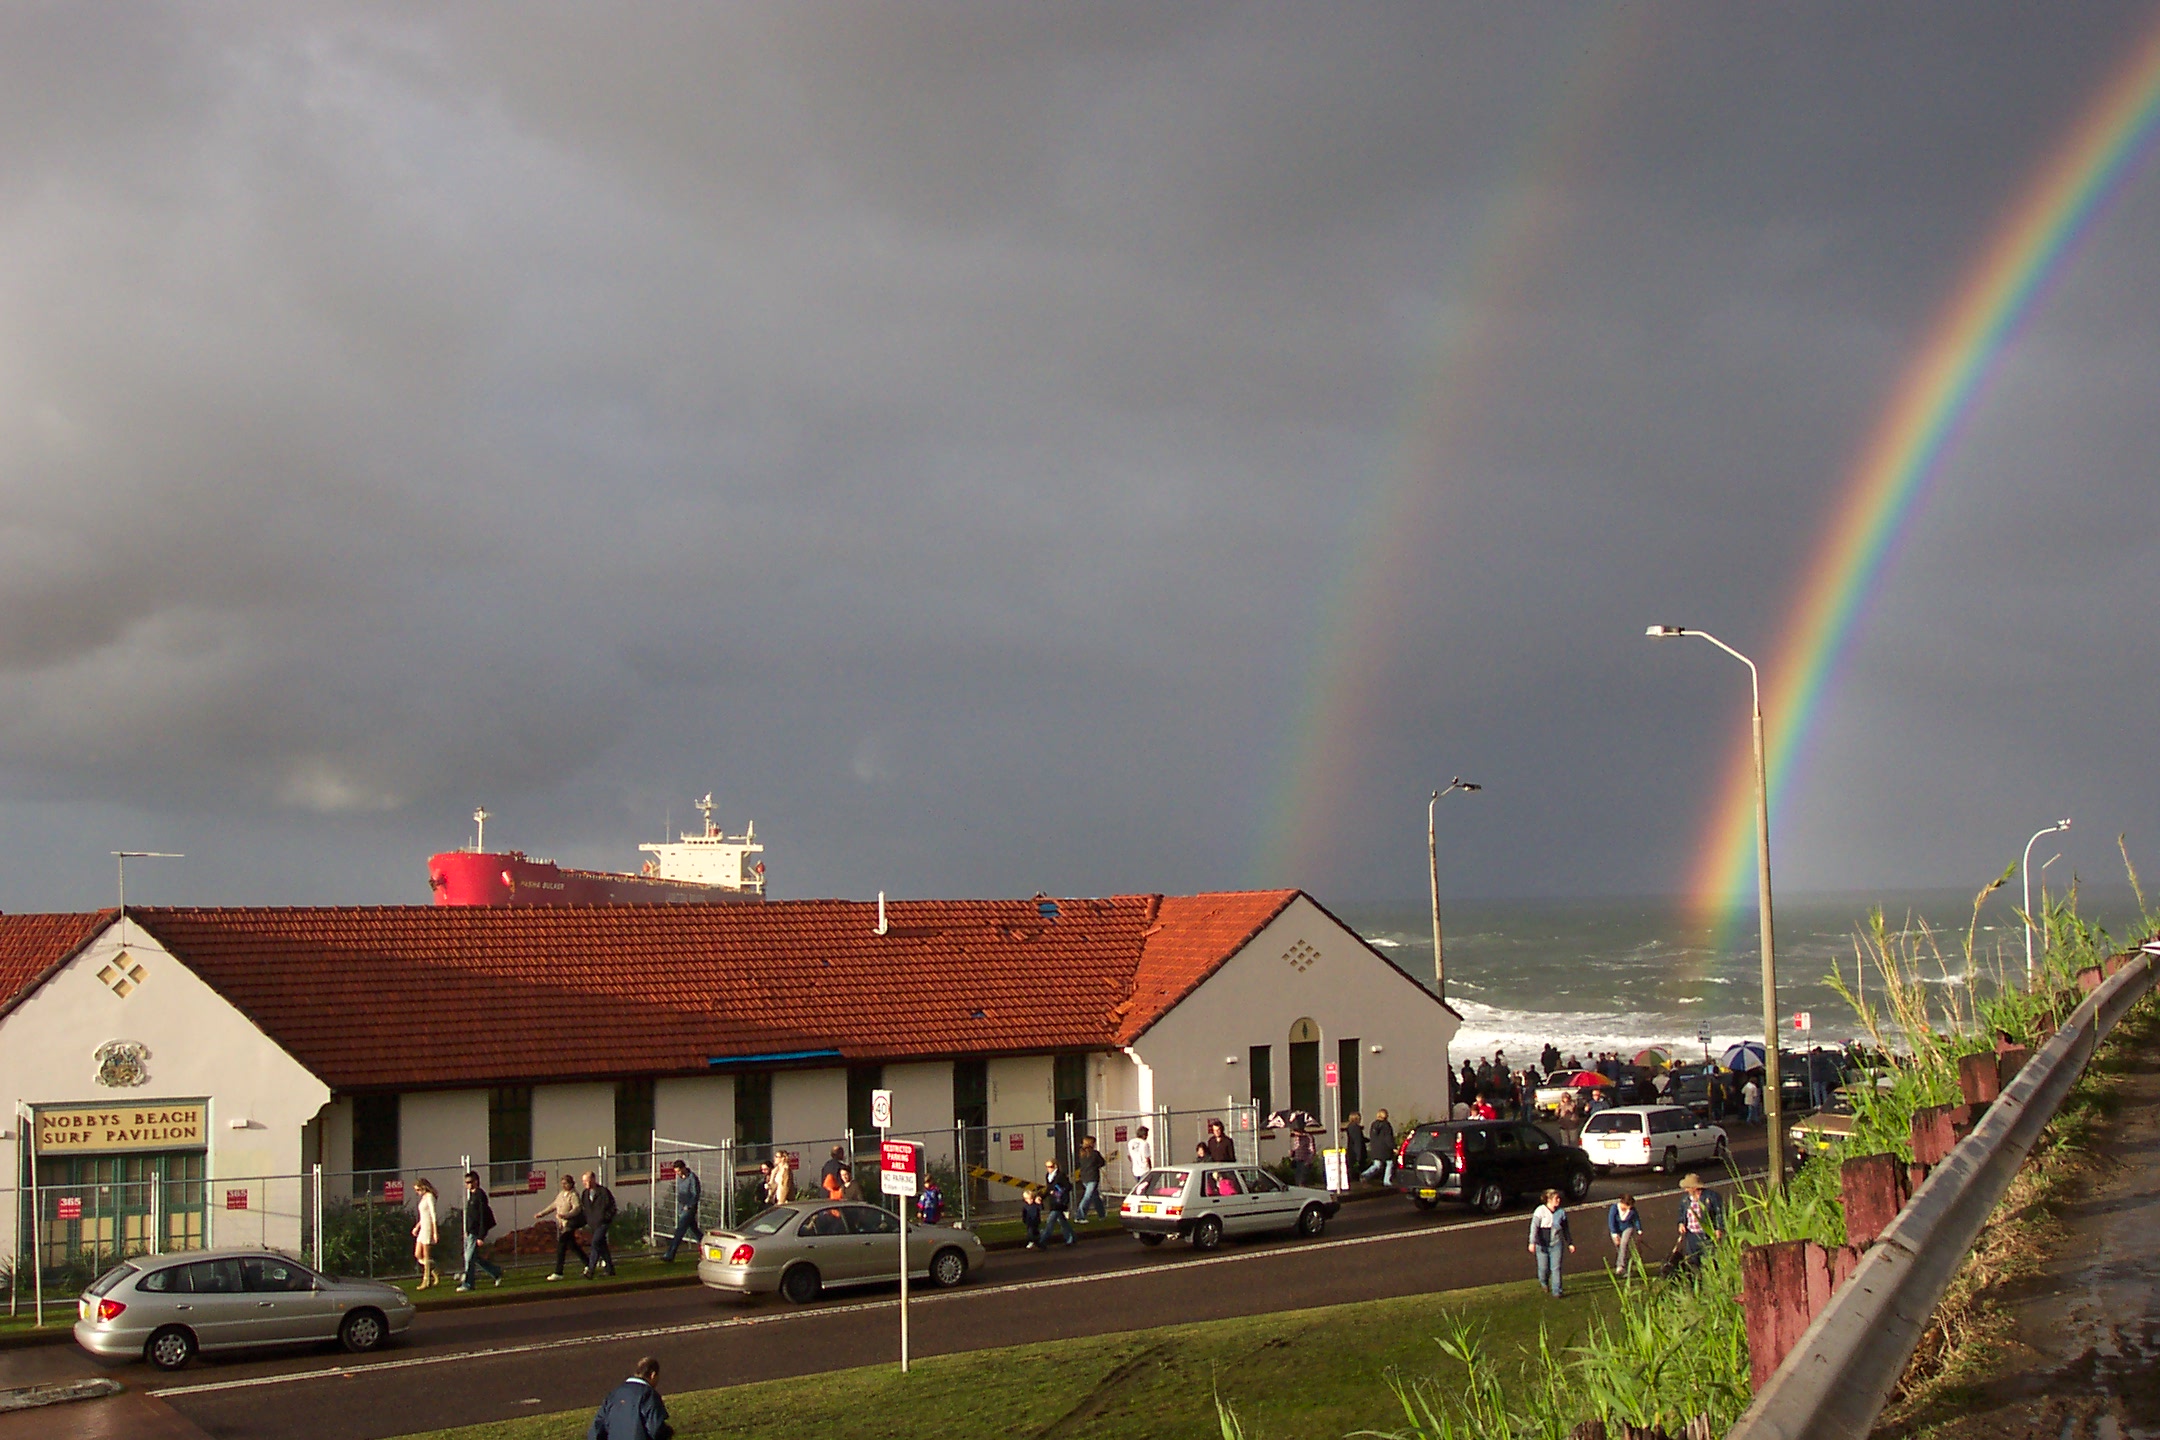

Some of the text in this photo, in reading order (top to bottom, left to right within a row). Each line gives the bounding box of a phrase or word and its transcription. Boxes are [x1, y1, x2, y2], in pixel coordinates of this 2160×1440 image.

[876, 1103, 887, 1115] 40
[43, 1111, 197, 1128] NOBBYS BEACH
[43, 1126, 197, 1144] SURF PAVILION
[883, 1144, 912, 1154] RESTRICTED
[887, 1153, 909, 1162] PARKING
[891, 1162, 906, 1170] AREA
[60, 1197, 82, 1206] 365
